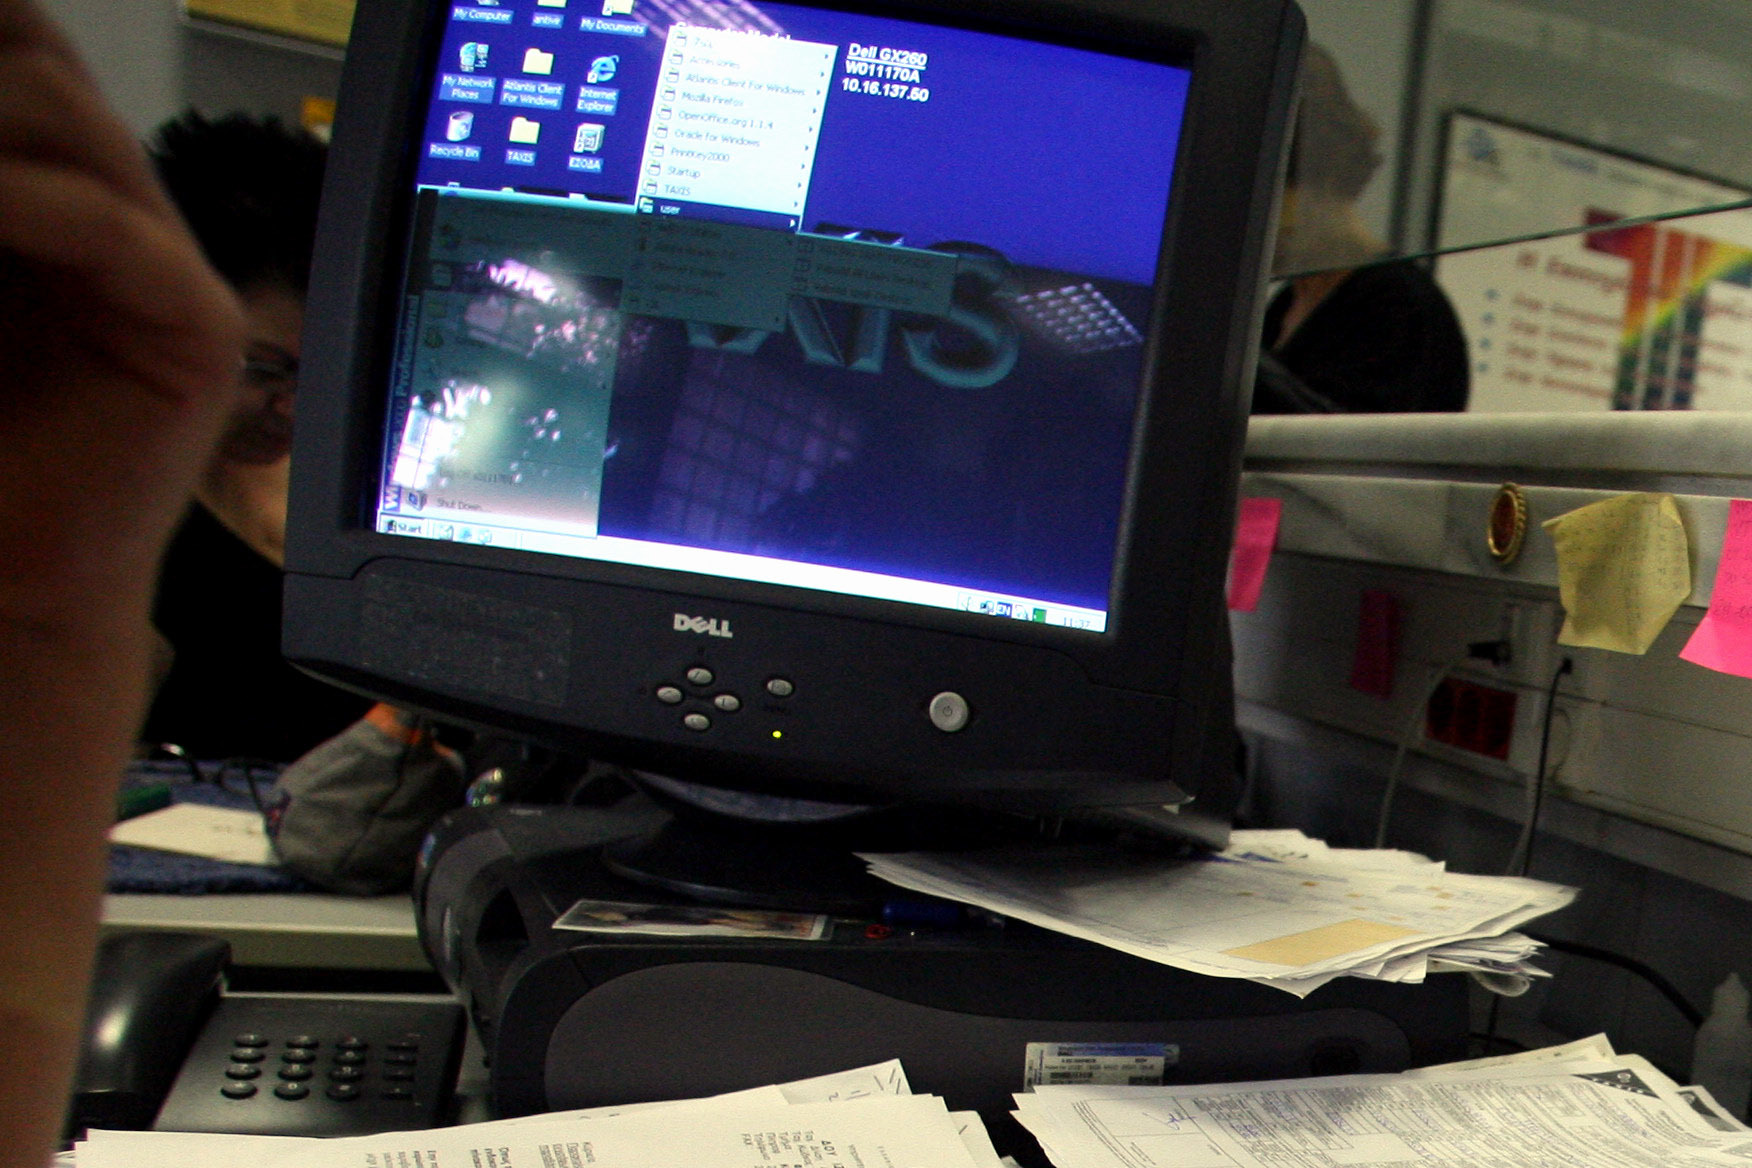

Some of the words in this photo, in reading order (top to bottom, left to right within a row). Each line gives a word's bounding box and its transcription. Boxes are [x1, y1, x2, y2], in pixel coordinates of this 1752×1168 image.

[453, 8, 467, 20] My
[468, 10, 511, 22] Computer
[580, 18, 594, 31] My
[596, 20, 645, 34] Documents
[848, 43, 878, 59] Dell
[879, 48, 928, 66] GX260
[845, 60, 921, 84] W011170A
[443, 76, 457, 88] My
[458, 77, 494, 89] Network
[503, 81, 536, 93] Atlantis
[538, 84, 563, 95] Client
[452, 89, 480, 99] Places
[503, 93, 518, 103] For
[520, 95, 560, 107] Windows
[580, 88, 617, 100] Internet
[578, 100, 615, 113] Explorer
[430, 144, 464, 157] Recycle
[465, 147, 480, 158] Bin
[507, 151, 534, 164] TAXIS
[667, 165, 701, 180] Startup
[664, 184, 691, 197] TAXIS
[660, 205, 681, 216] user
[398, 522, 422, 535] Start
[673, 612, 733, 639] DELL
